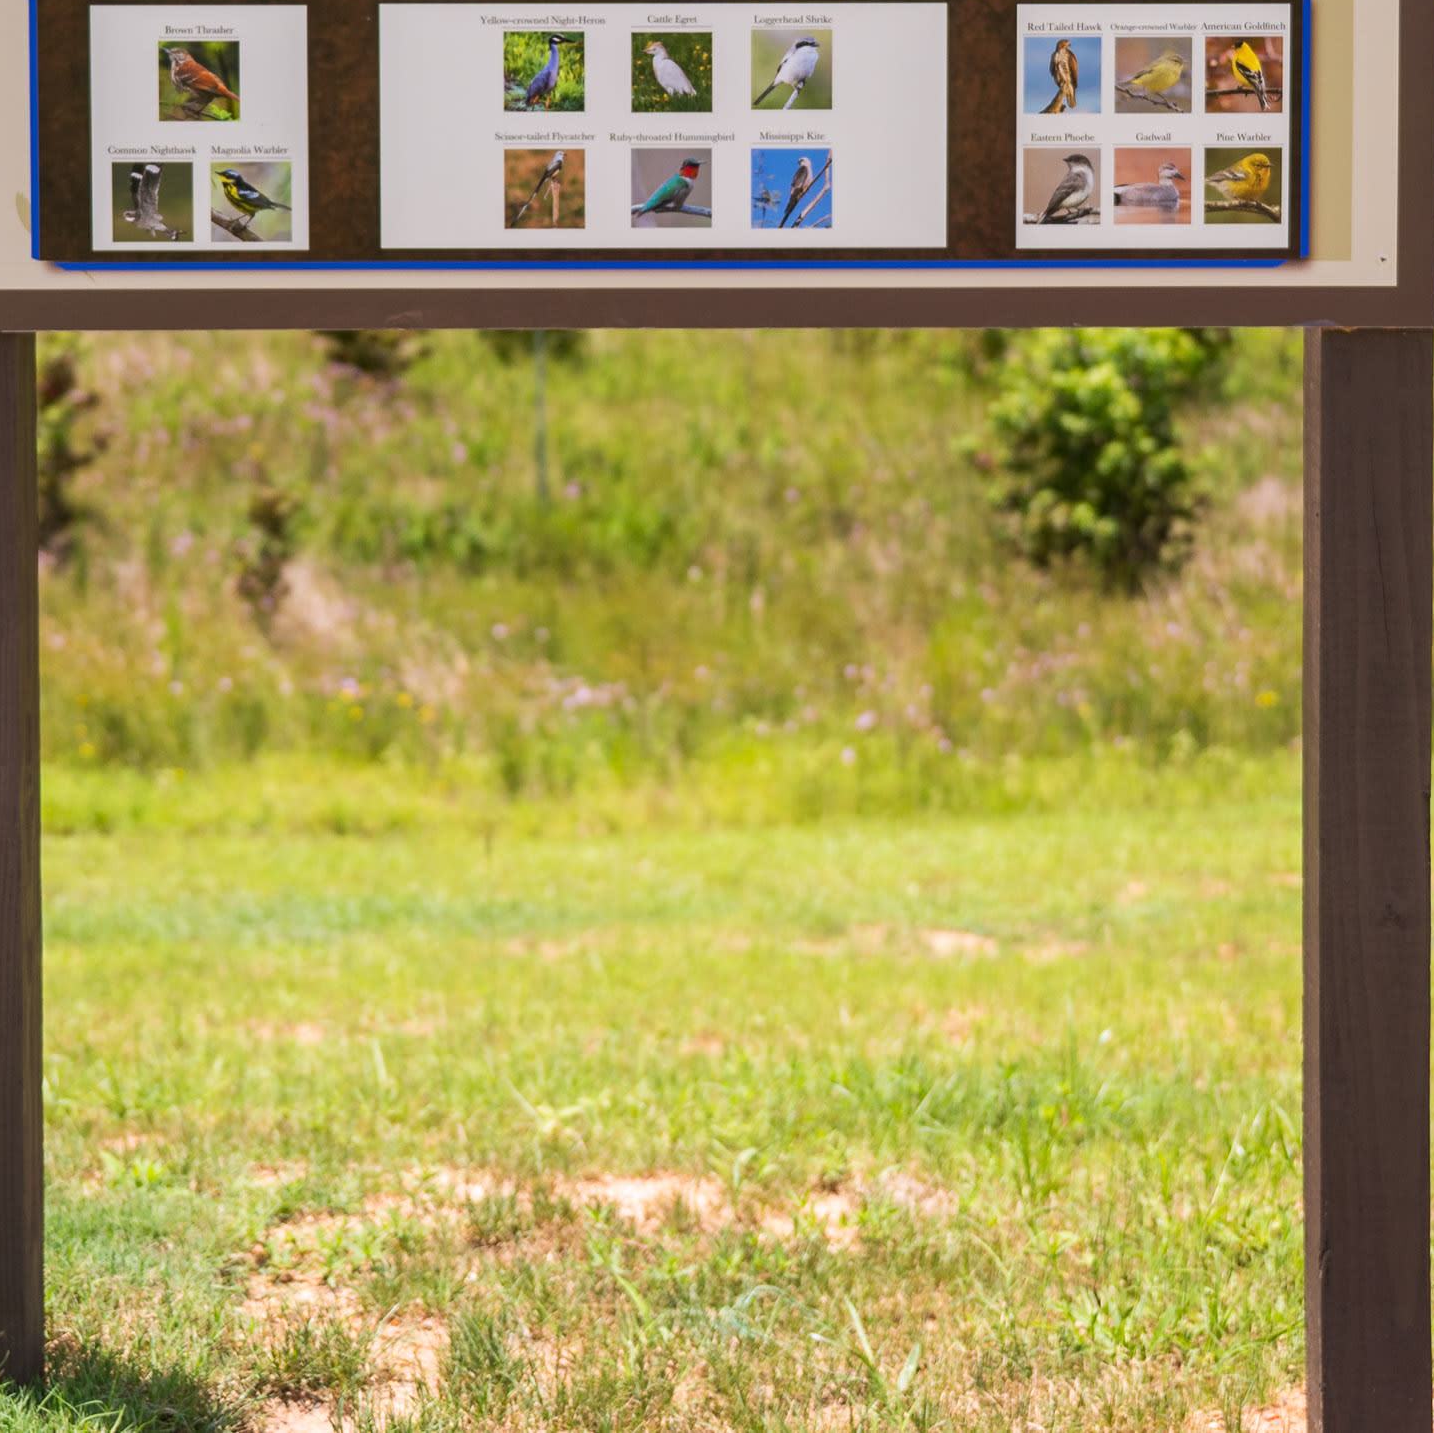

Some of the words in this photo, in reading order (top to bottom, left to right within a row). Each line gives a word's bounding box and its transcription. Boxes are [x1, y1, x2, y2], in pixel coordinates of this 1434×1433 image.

[480, 16, 549, 25] Yellow-crowned
[551, 16, 606, 26] Night-Heron
[647, 15, 673, 23] Cattle
[675, 15, 697, 24] Egret
[753, 15, 804, 26] Loggerhead
[805, 15, 832, 23] Shrike
[165, 26, 193, 34] Brown
[1027, 23, 1045, 31] Red
[1048, 22, 1074, 31] Tailed
[1077, 22, 1102, 31] Hawk
[1201, 22, 1242, 30] American
[1244, 22, 1286, 30] Goldfinch
[551, 132, 595, 142] Flycatcher
[609, 133, 672, 142] Ruby-throated
[674, 133, 735, 143] Hummingbird
[808, 132, 825, 140] Kite
[1030, 133, 1062, 142] Eastern
[1064, 133, 1095, 142] Phoebe
[1135, 133, 1172, 141] Gadwall
[1216, 133, 1235, 141] Pine
[1237, 133, 1271, 141] Warbler
[107, 146, 149, 154] Common
[150, 146, 197, 155] Nighthawk
[210, 146, 252, 155] Magnolia
[253, 146, 289, 154] Warbler
